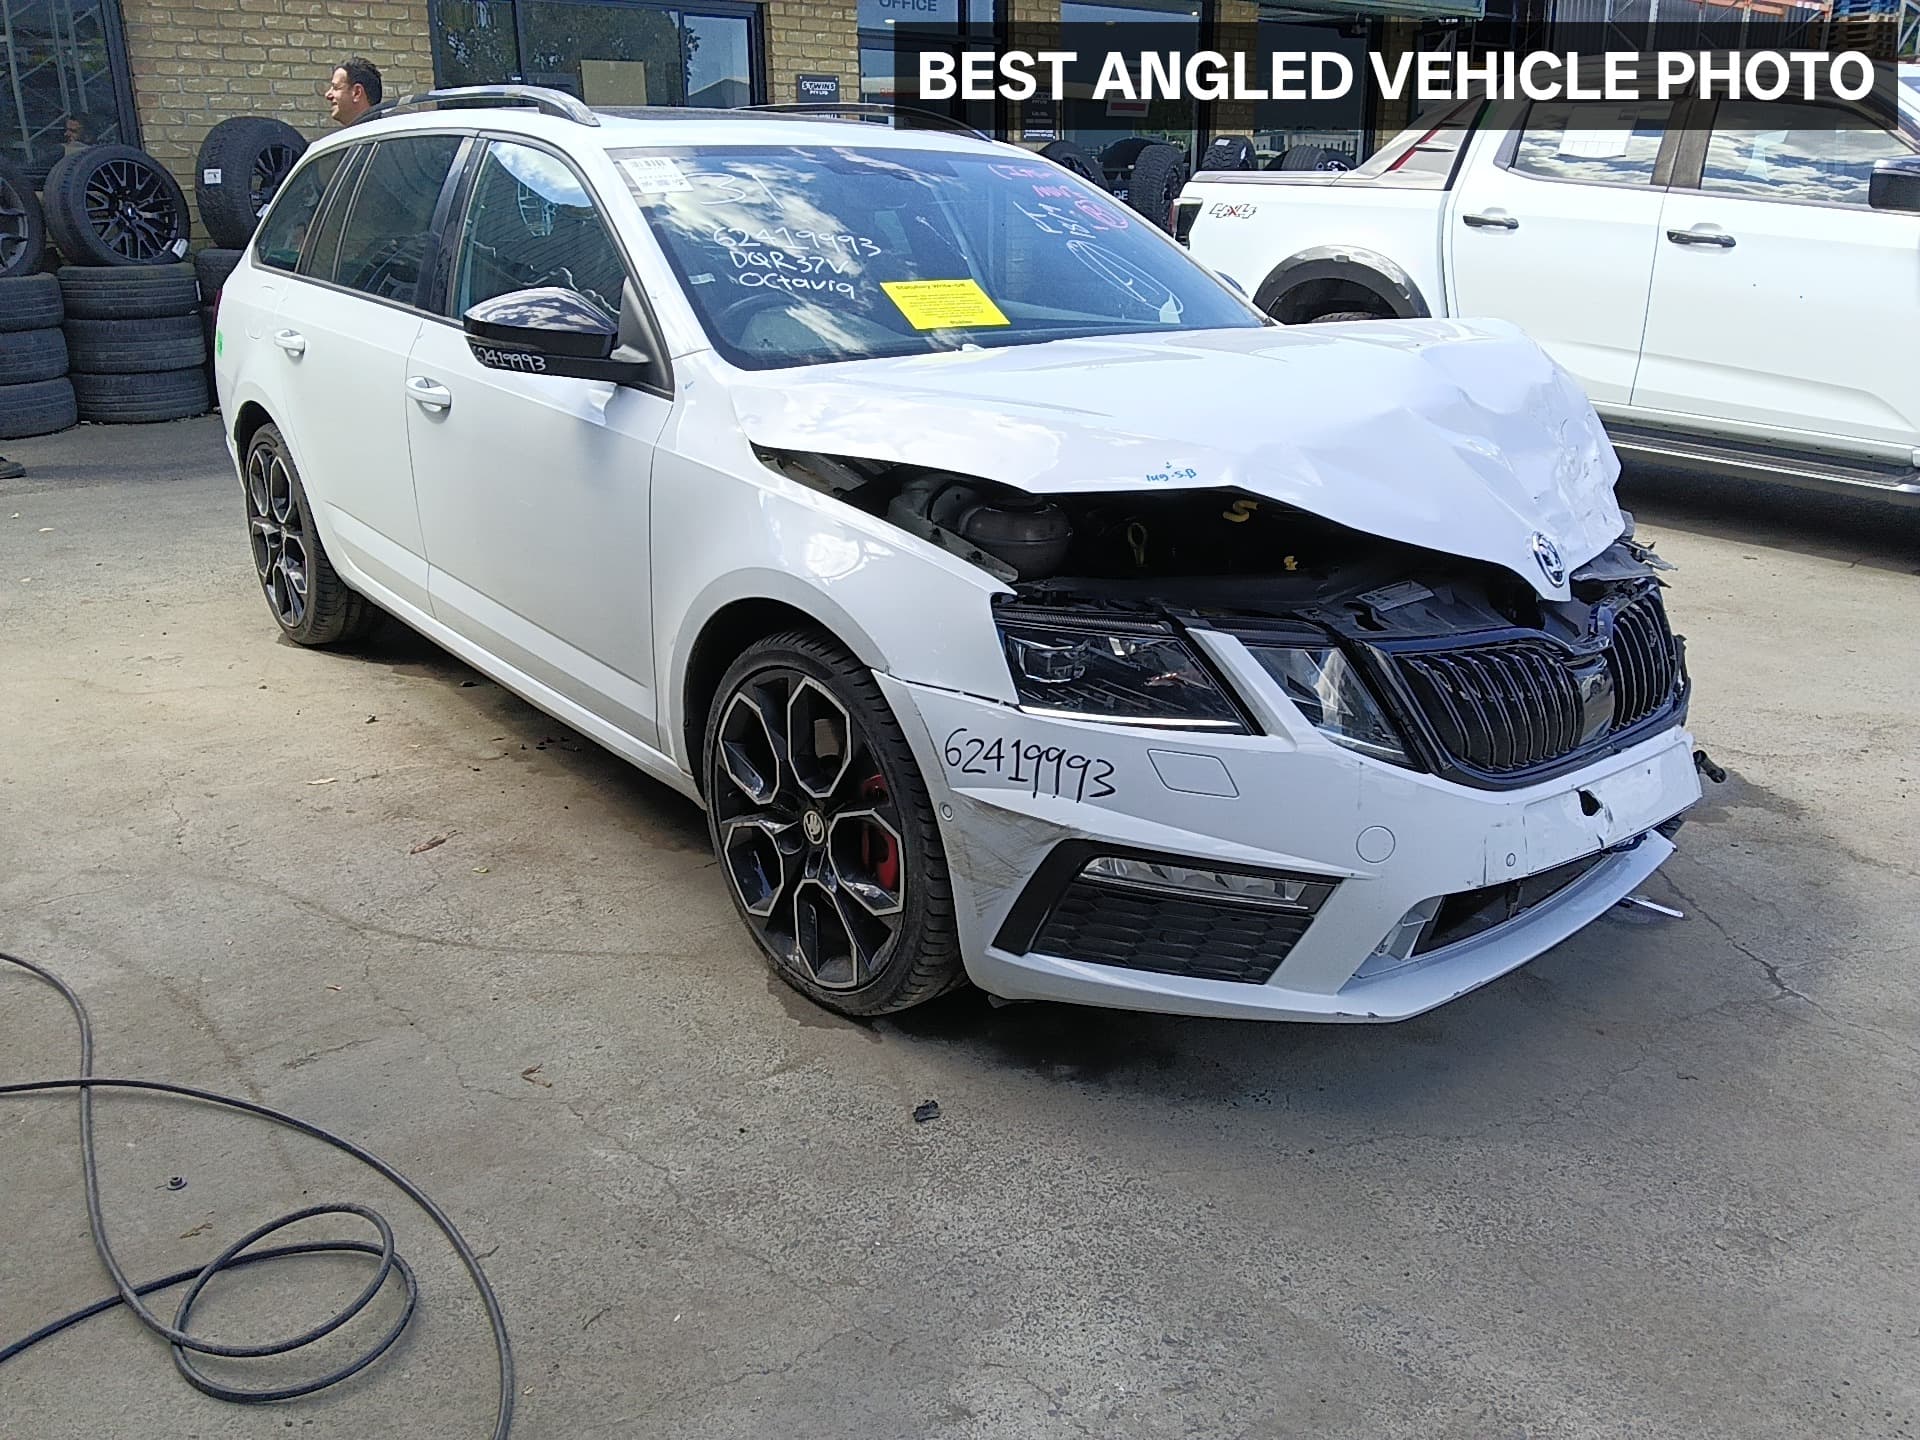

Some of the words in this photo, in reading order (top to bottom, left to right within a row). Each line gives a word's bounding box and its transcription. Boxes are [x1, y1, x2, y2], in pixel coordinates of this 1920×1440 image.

[879, 0, 937, 11] OFFICE
[713, 227, 882, 257] 62419993
[944, 728, 1117, 804] 62419993
